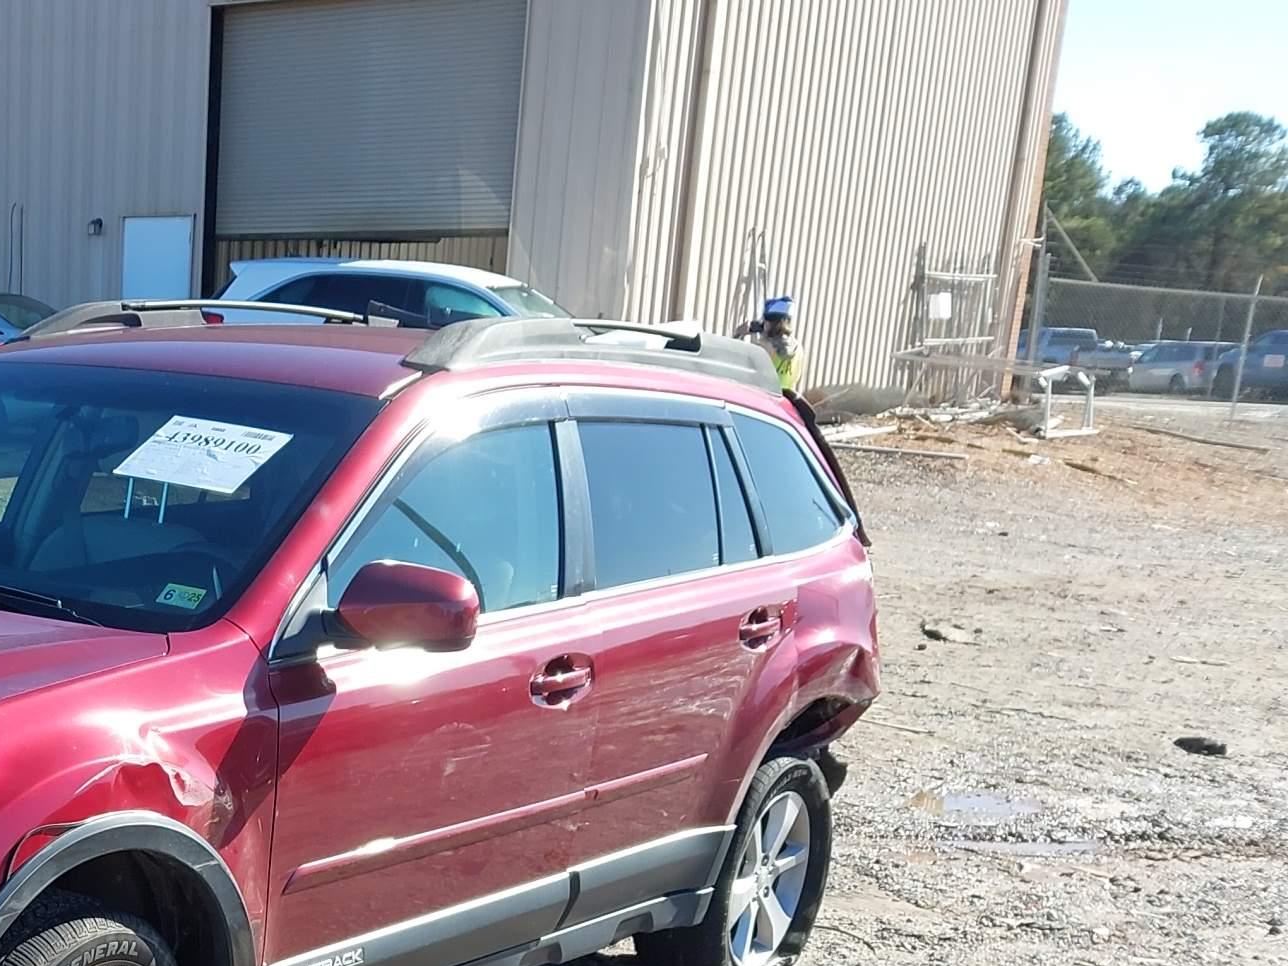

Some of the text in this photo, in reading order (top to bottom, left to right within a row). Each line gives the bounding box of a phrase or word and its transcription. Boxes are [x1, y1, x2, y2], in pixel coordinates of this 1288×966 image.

[165, 431, 263, 455] 43989100
[163, 589, 202, 603] 6 25
